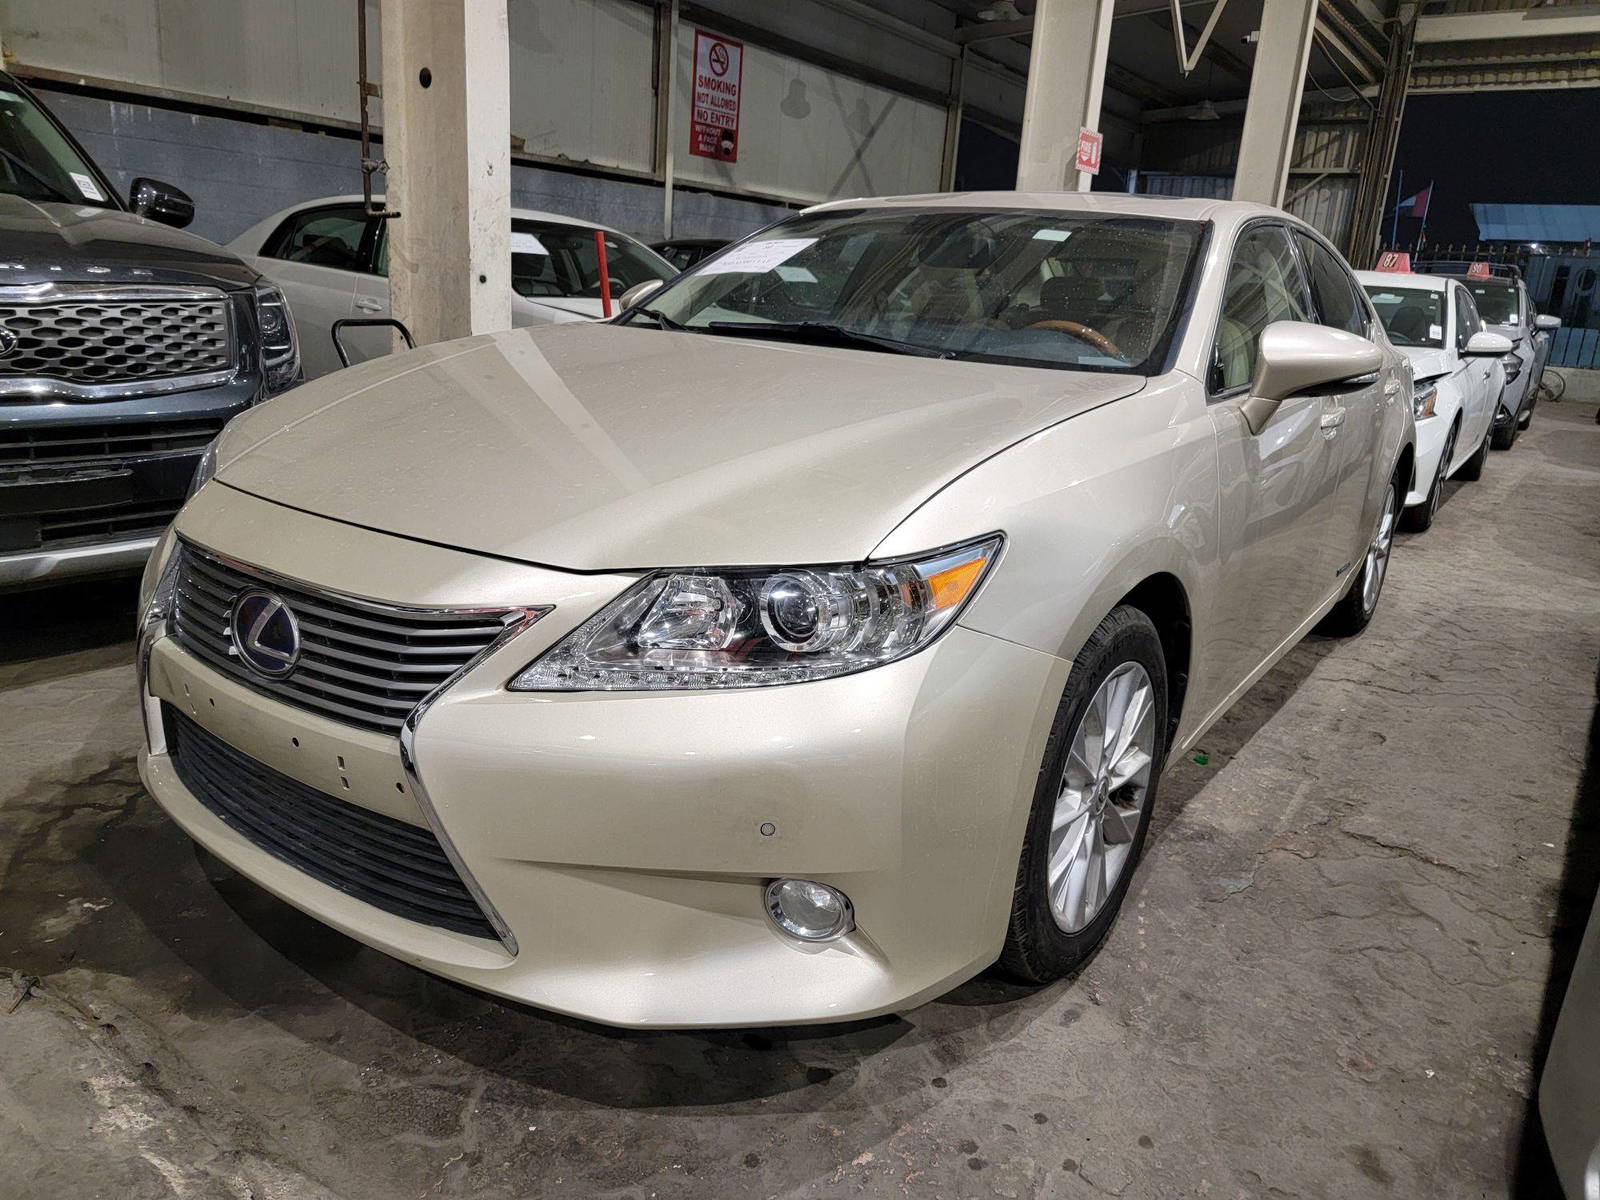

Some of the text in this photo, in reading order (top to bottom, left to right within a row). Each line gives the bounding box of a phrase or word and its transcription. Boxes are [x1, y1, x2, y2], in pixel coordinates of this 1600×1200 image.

[698, 75, 736, 96] SMOKING
[696, 92, 736, 111] NOT ALLOWED
[697, 109, 735, 127] NO ENTRY
[1383, 253, 1398, 267] 87
